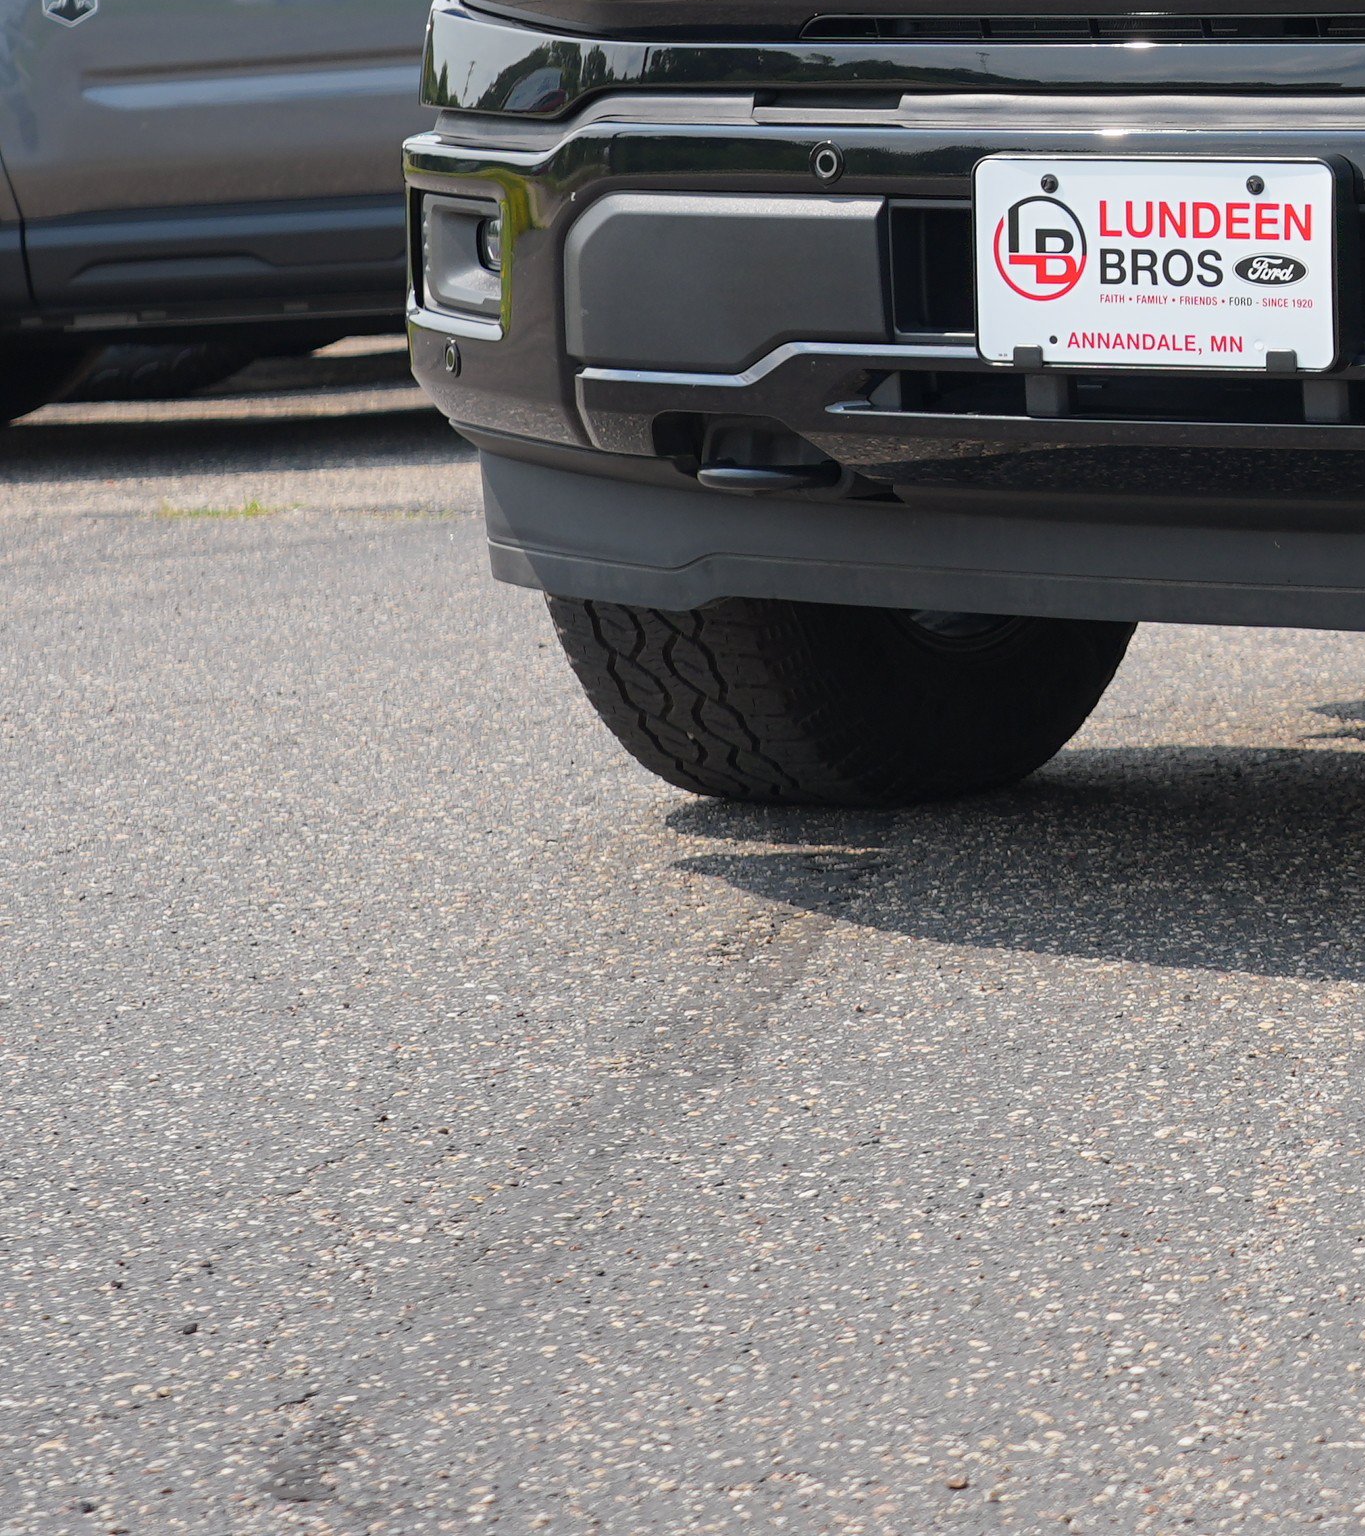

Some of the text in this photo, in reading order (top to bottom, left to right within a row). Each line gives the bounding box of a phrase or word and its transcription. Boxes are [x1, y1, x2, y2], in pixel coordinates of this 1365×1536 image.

[1099, 200, 1312, 241] LUNDEEN
[1099, 248, 1224, 287] BROS
[1099, 294, 1313, 309] FAITH FAMILY FRIENDS FORD SINCE 1920
[1067, 331, 1244, 354] ANNANDALE, MN
